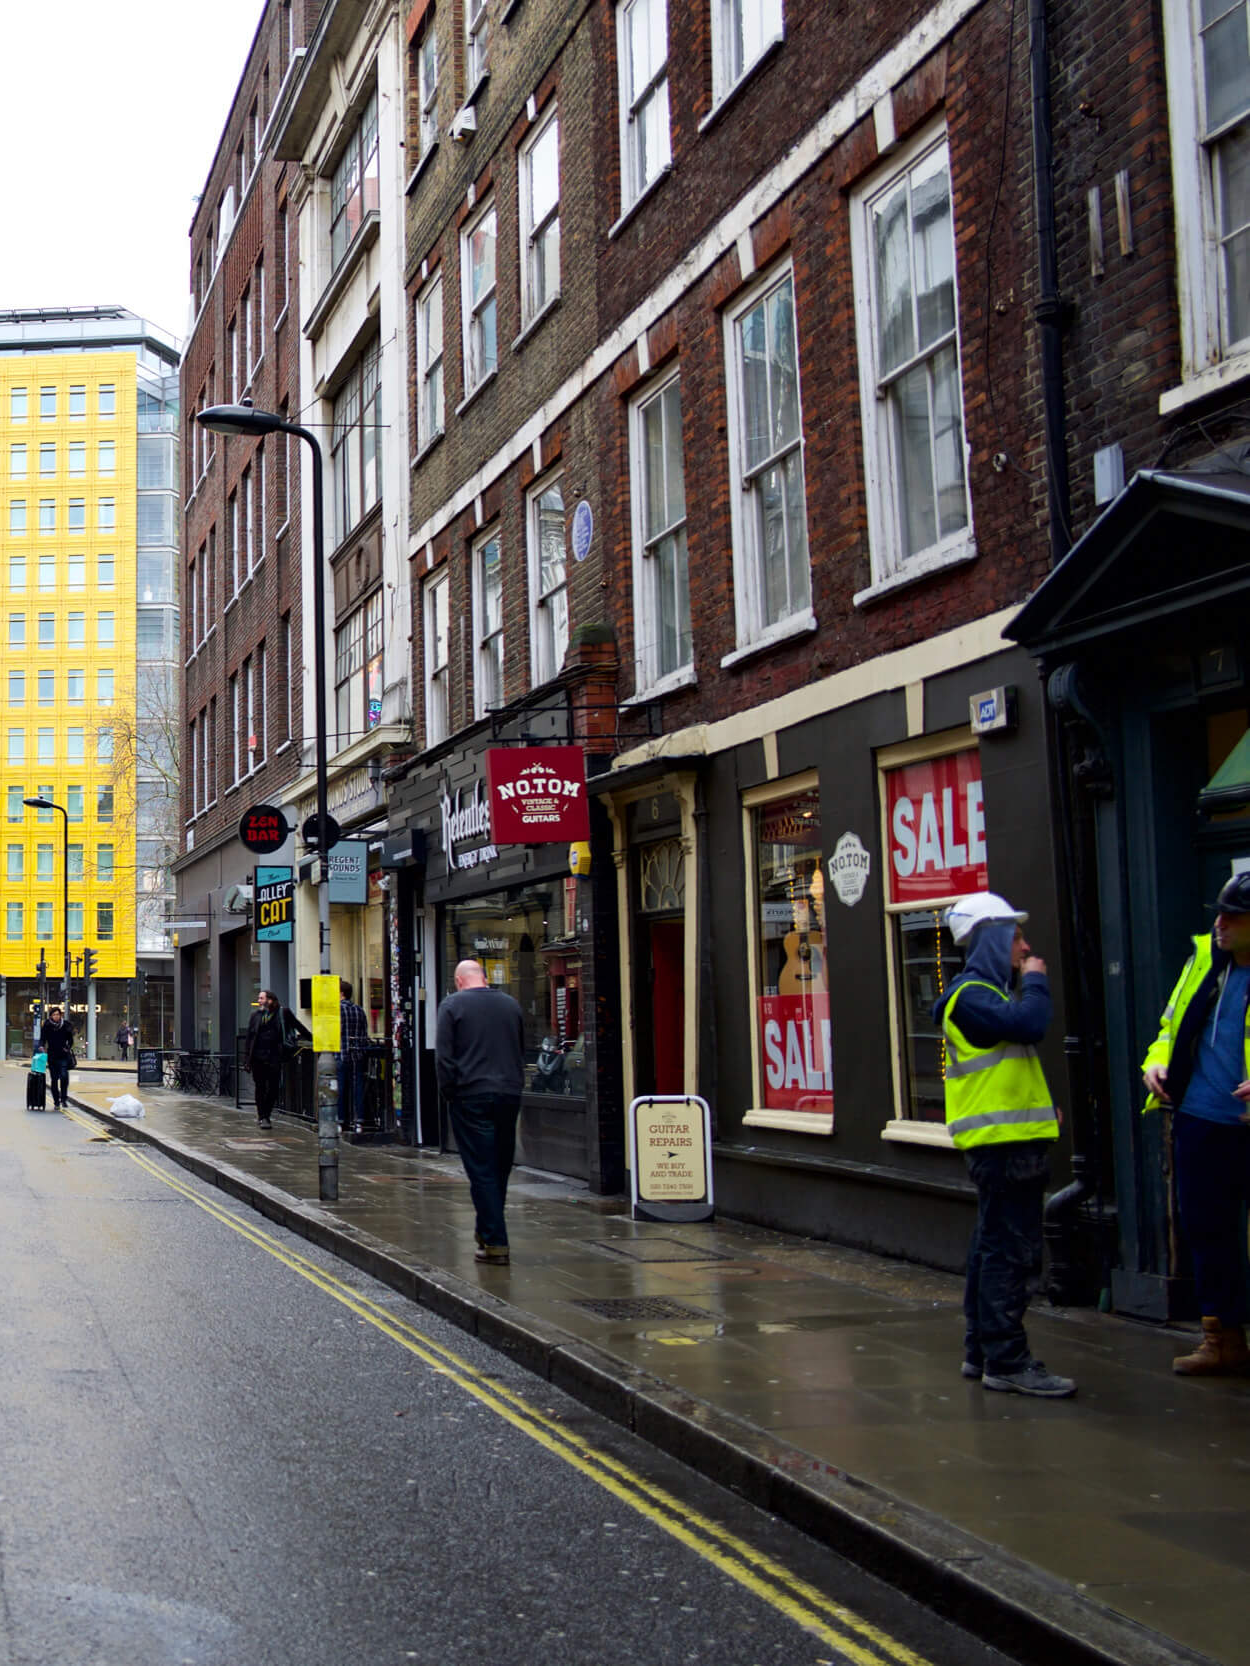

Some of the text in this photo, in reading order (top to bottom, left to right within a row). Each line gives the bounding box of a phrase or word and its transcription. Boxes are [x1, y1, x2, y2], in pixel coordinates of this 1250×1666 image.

[497, 778, 581, 800] NO.TOM
[651, 798, 660, 820] 6
[248, 815, 279, 829] ZEN
[522, 814, 561, 823] GUITARS
[246, 829, 280, 842] BAR
[893, 780, 987, 878] SALE
[329, 855, 360, 864] REGENT
[831, 853, 868, 875] NO.TOM
[257, 882, 291, 902] ALLEY
[260, 897, 292, 926] CAT
[648, 1124, 690, 1134] GUITAR
[648, 1137, 693, 1147] REPAIRS
[656, 1162, 686, 1170] WE BUY
[650, 1170, 694, 1178] AND TRADE
